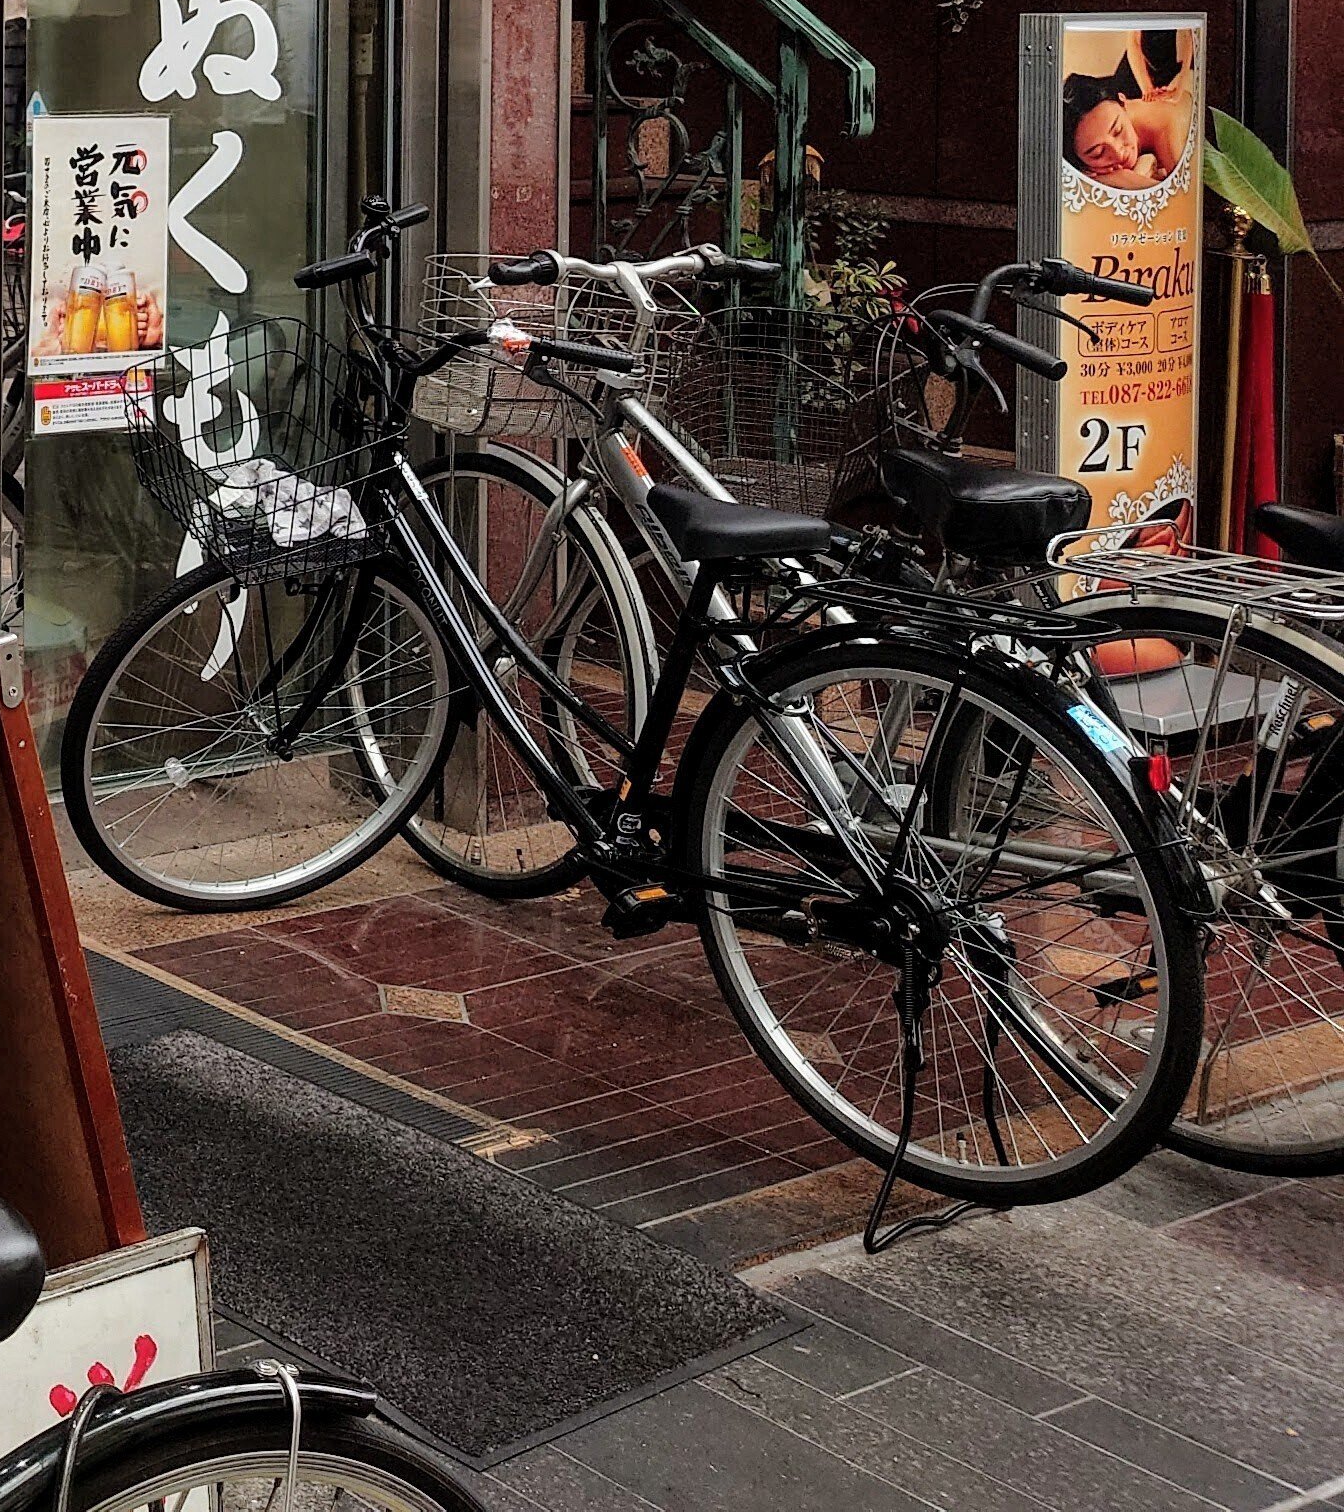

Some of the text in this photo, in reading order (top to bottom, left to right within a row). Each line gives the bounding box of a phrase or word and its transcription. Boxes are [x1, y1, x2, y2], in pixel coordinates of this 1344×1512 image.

[69, 143, 105, 267] 営業中
[108, 143, 141, 248] 元気に
[1081, 247, 1194, 303] Biraku
[1092, 320, 1147, 337] ボディケア
[1080, 357, 1175, 377] 30分 ¥3,000 20分
[1078, 417, 1147, 473] 2F
[408, 560, 448, 626] COCONUT
